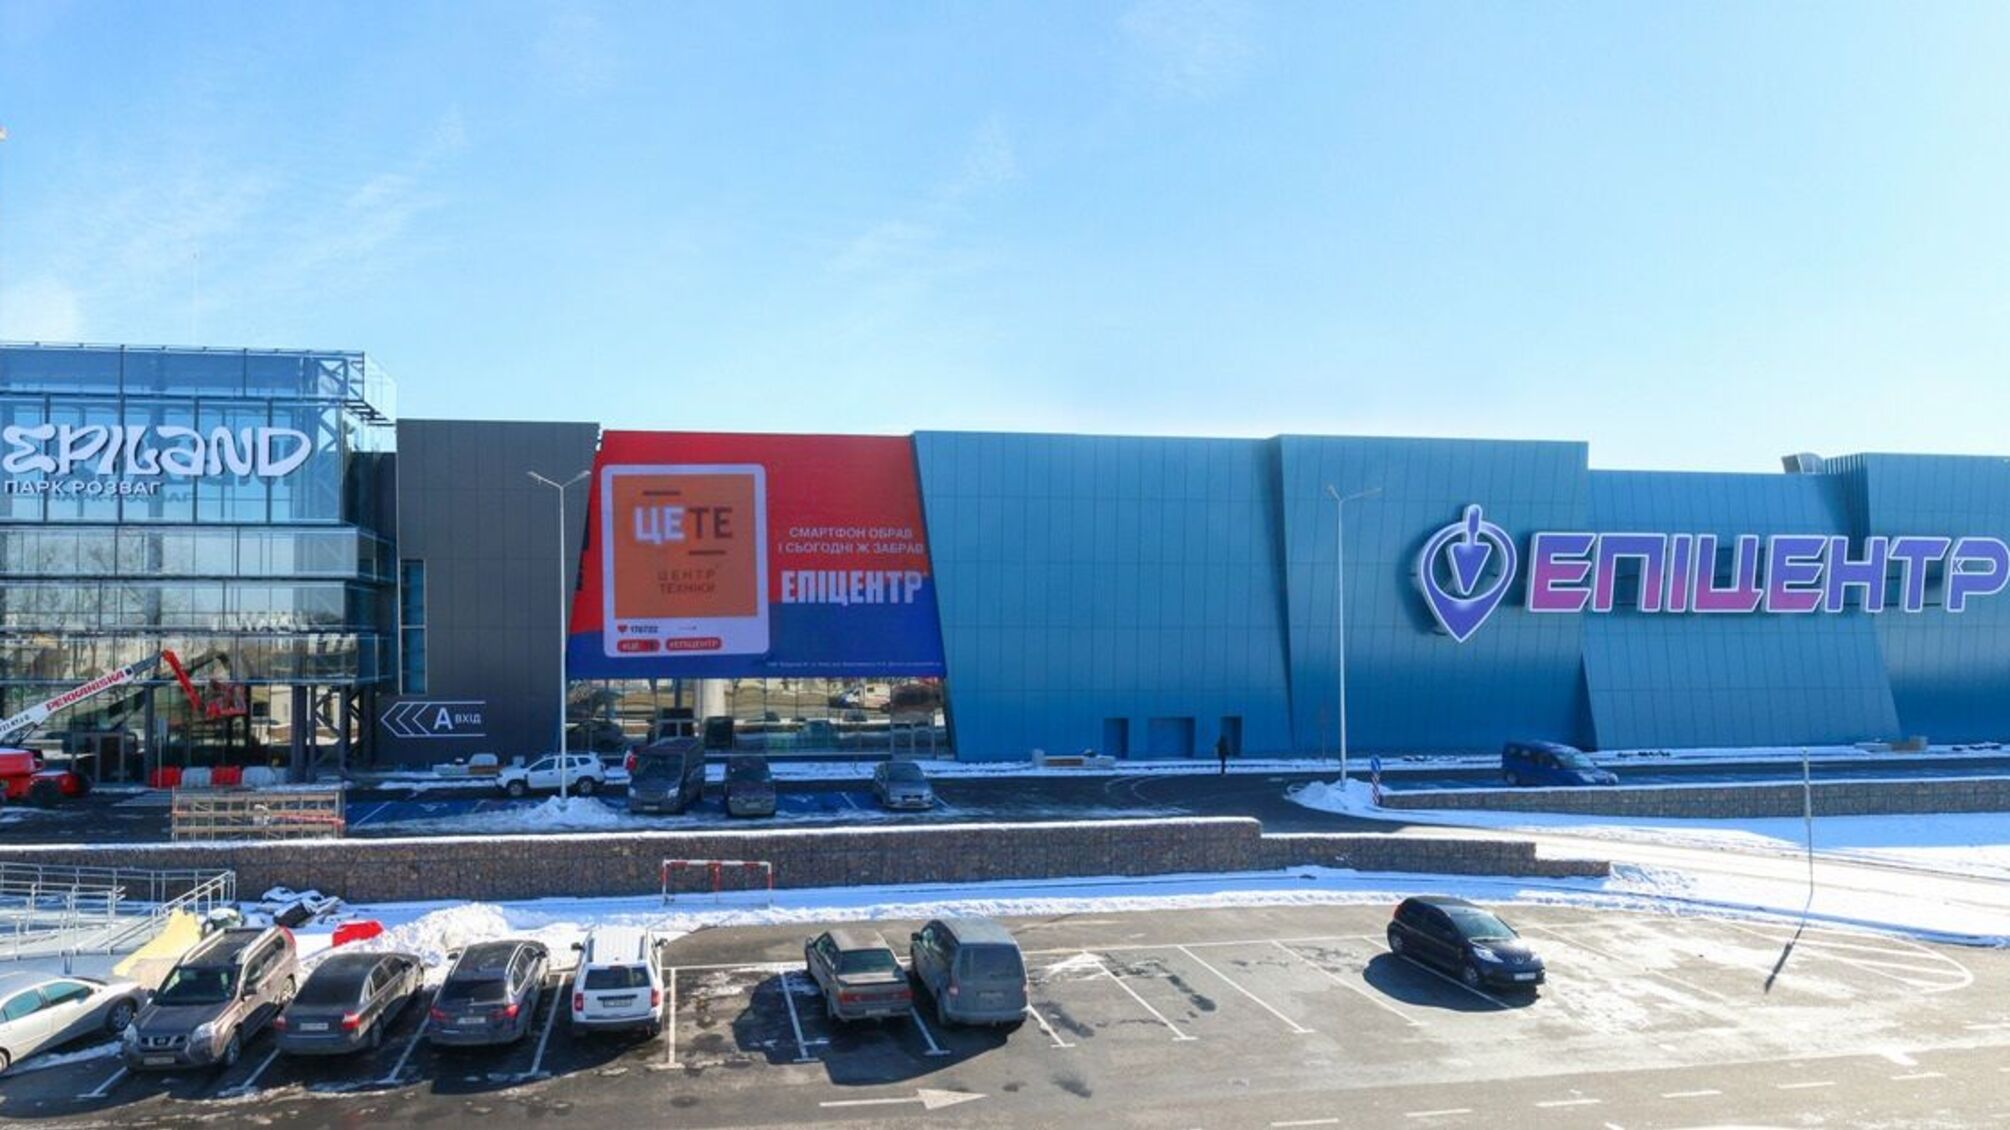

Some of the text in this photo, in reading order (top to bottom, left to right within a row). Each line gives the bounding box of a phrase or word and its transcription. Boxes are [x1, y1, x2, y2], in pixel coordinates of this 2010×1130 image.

[4, 480, 160, 495] ПАРК РОЗВАГ
[634, 506, 733, 545] ЦЕТЕ
[789, 527, 913, 538] СМАРТФОН ОБРАВ
[786, 543, 853, 554] СЬОГОДНІ
[857, 543, 869, 553] Ж
[873, 543, 924, 554] ЗАБРАВ
[1528, 532, 2010, 613] ЕПІЦЕНТР
[781, 570, 923, 606] ЕПІЦЕНТР
[455, 713, 482, 724] ВХІД
